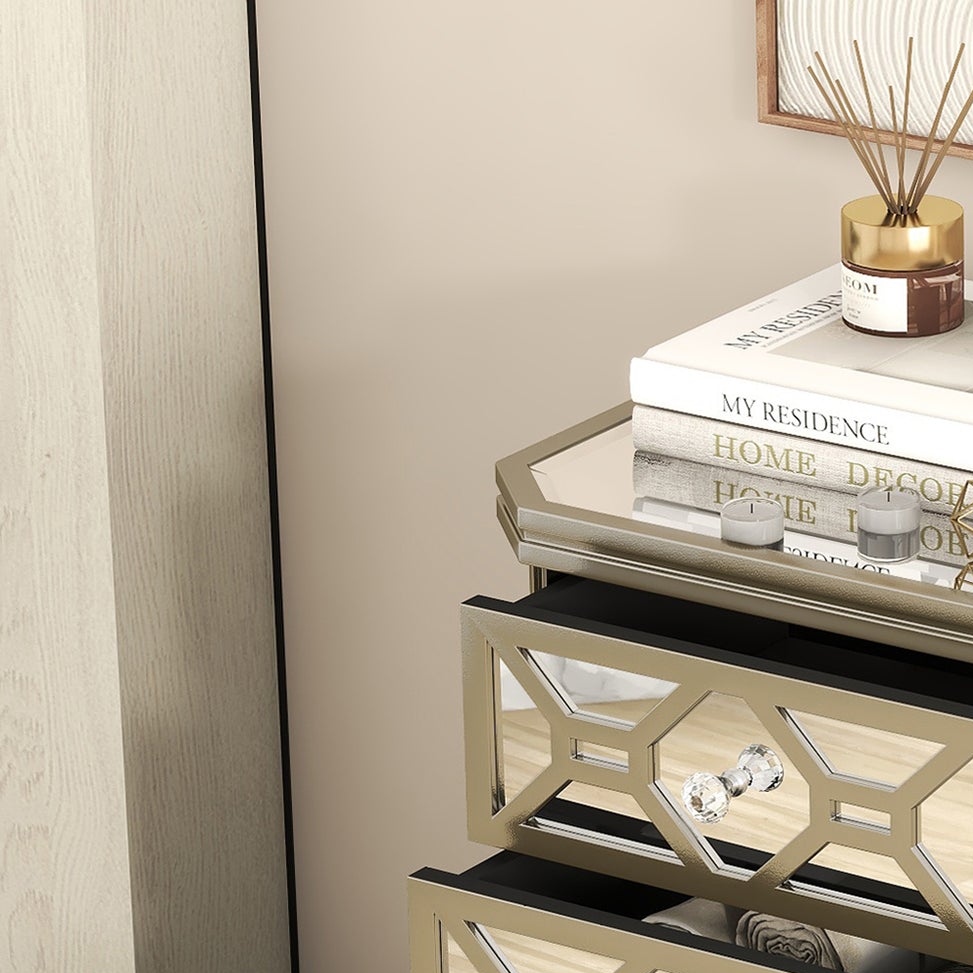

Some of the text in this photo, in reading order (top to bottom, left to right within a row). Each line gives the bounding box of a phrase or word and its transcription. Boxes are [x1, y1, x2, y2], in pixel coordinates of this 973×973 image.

[842, 275, 878, 295] EOM
[724, 330, 769, 350] MY
[762, 290, 843, 333] RESIDEN
[721, 393, 891, 446] MY RESIDENCE
[713, 433, 817, 477] HOME
